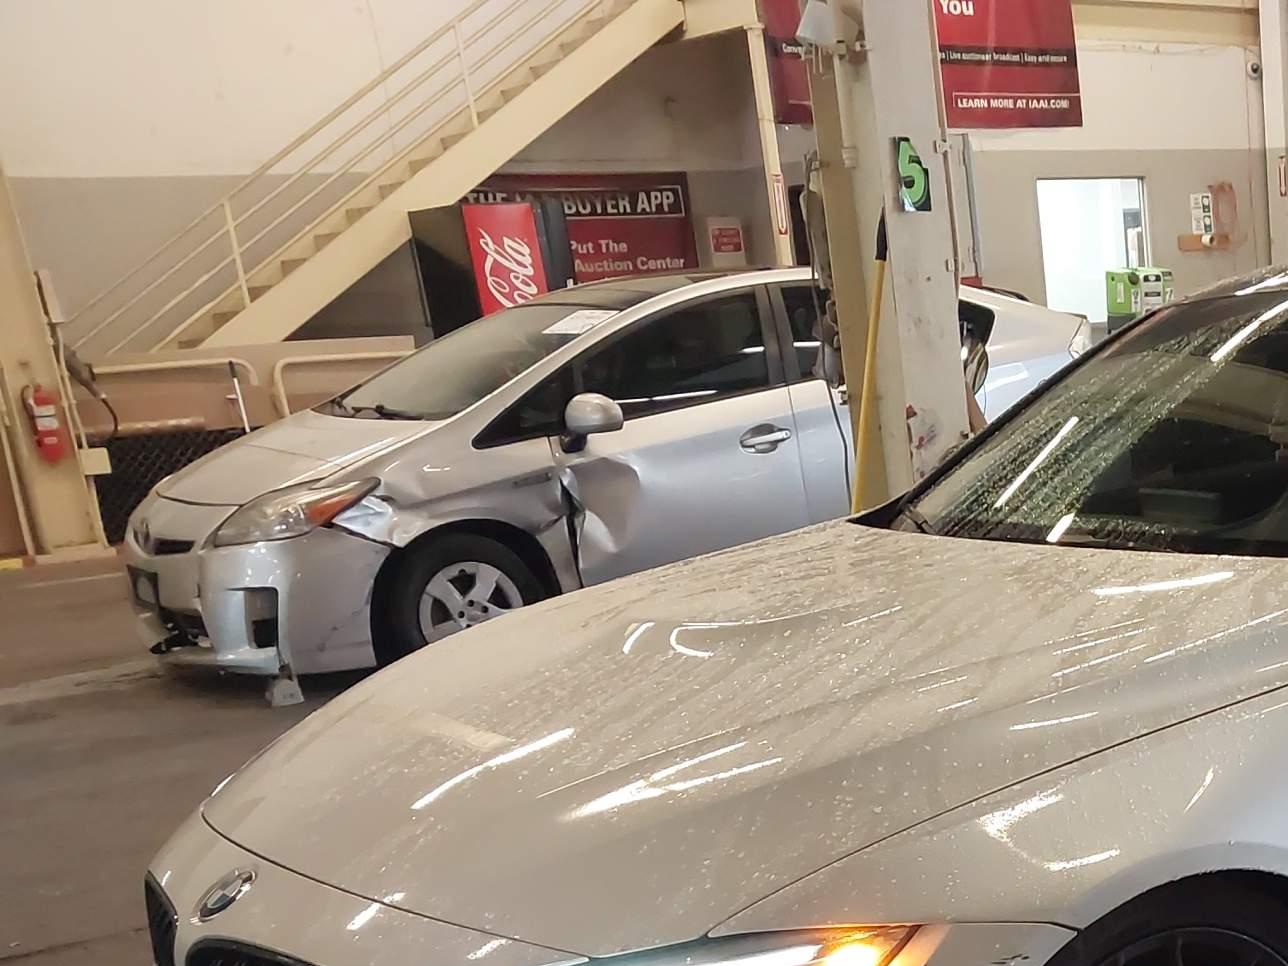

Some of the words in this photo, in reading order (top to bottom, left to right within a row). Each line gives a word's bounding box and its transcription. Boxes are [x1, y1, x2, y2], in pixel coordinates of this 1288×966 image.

[940, 0, 974, 16] You
[957, 98, 988, 109] LEARN
[990, 98, 1015, 109] MORE
[1016, 99, 1027, 109] AT
[898, 140, 927, 206] 5
[562, 192, 631, 214] BUYER
[636, 190, 676, 213] APP
[598, 239, 628, 253] The
[574, 258, 633, 273] Auction
[637, 256, 686, 271] Center
